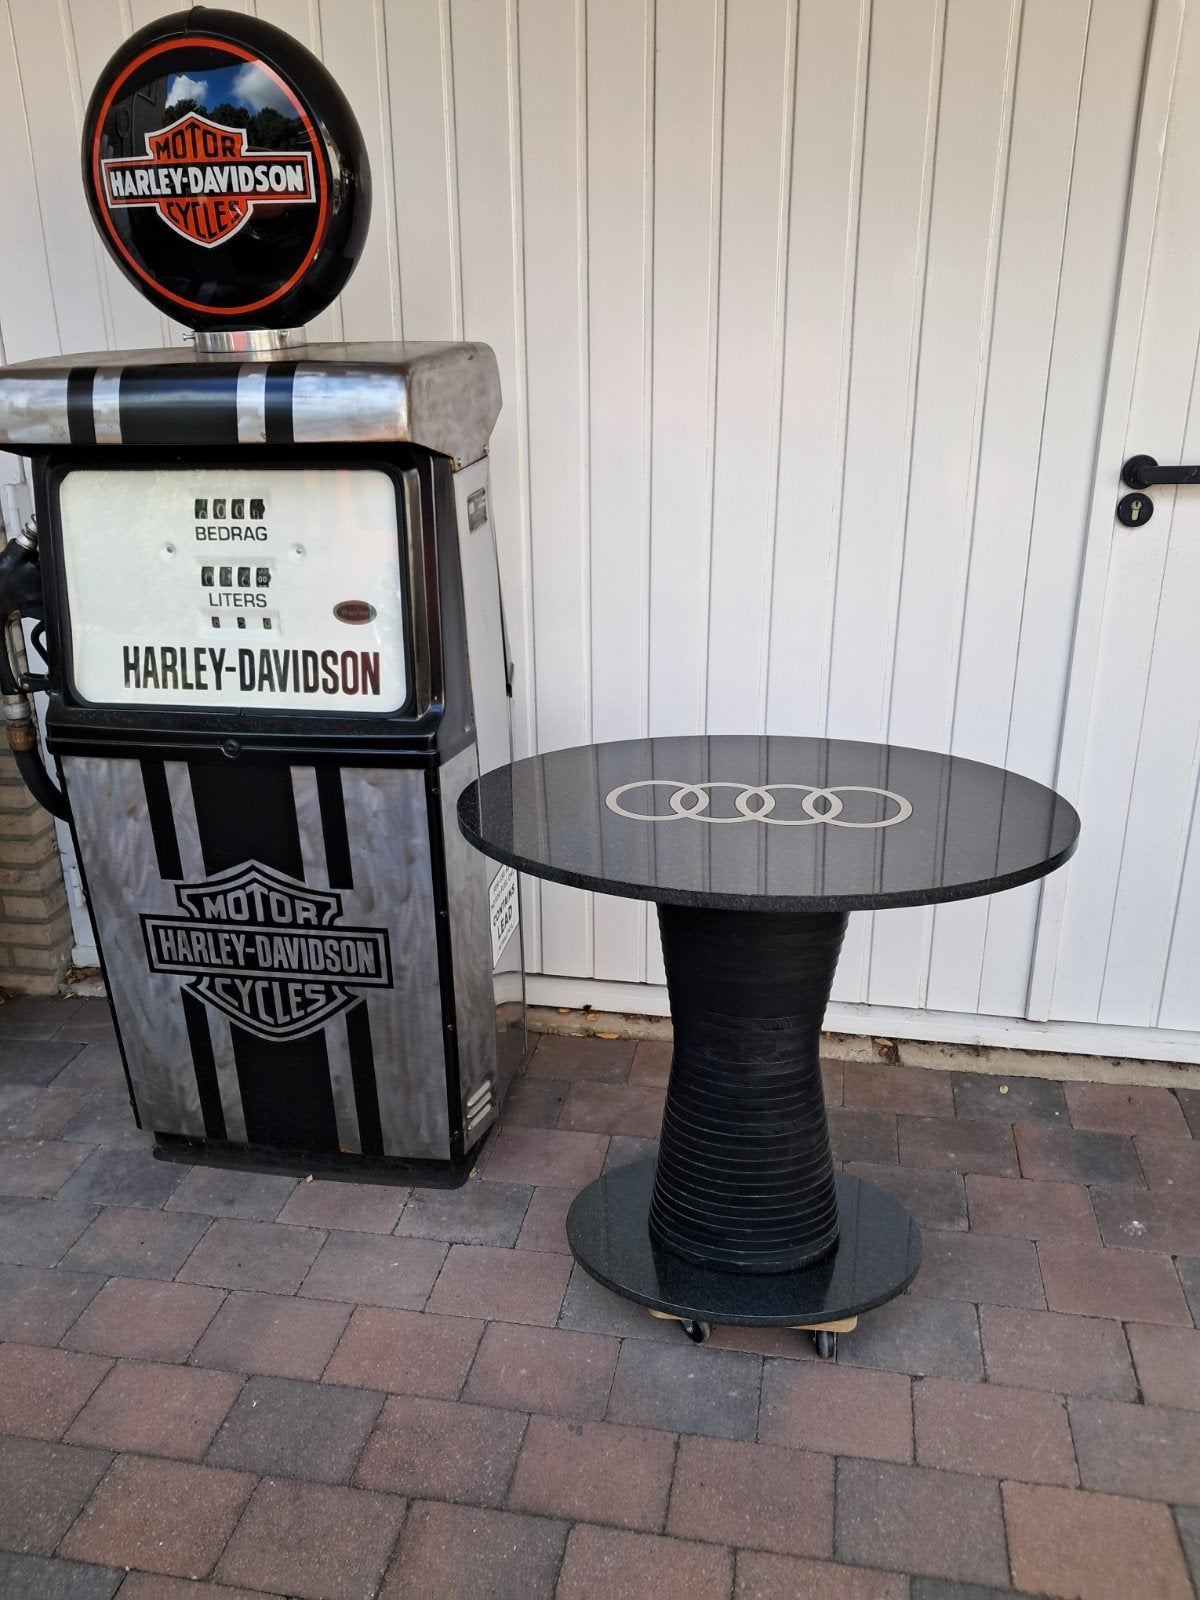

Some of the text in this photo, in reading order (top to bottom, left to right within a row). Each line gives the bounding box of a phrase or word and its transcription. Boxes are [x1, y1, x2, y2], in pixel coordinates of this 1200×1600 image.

[154, 122, 237, 161] MOTOR
[109, 164, 305, 197] HARLEY-DAVIDSON
[166, 200, 244, 240] CYCLES
[194, 526, 268, 541] BEDRAG
[208, 592, 268, 608] LITERS
[122, 645, 381, 696] HARLEY-DAVIDSON
[202, 882, 319, 926] MOTOR
[497, 904, 513, 940] LEAD
[157, 927, 377, 975] HARLEY-DAVIDSON
[214, 977, 328, 1026] CYCLES
